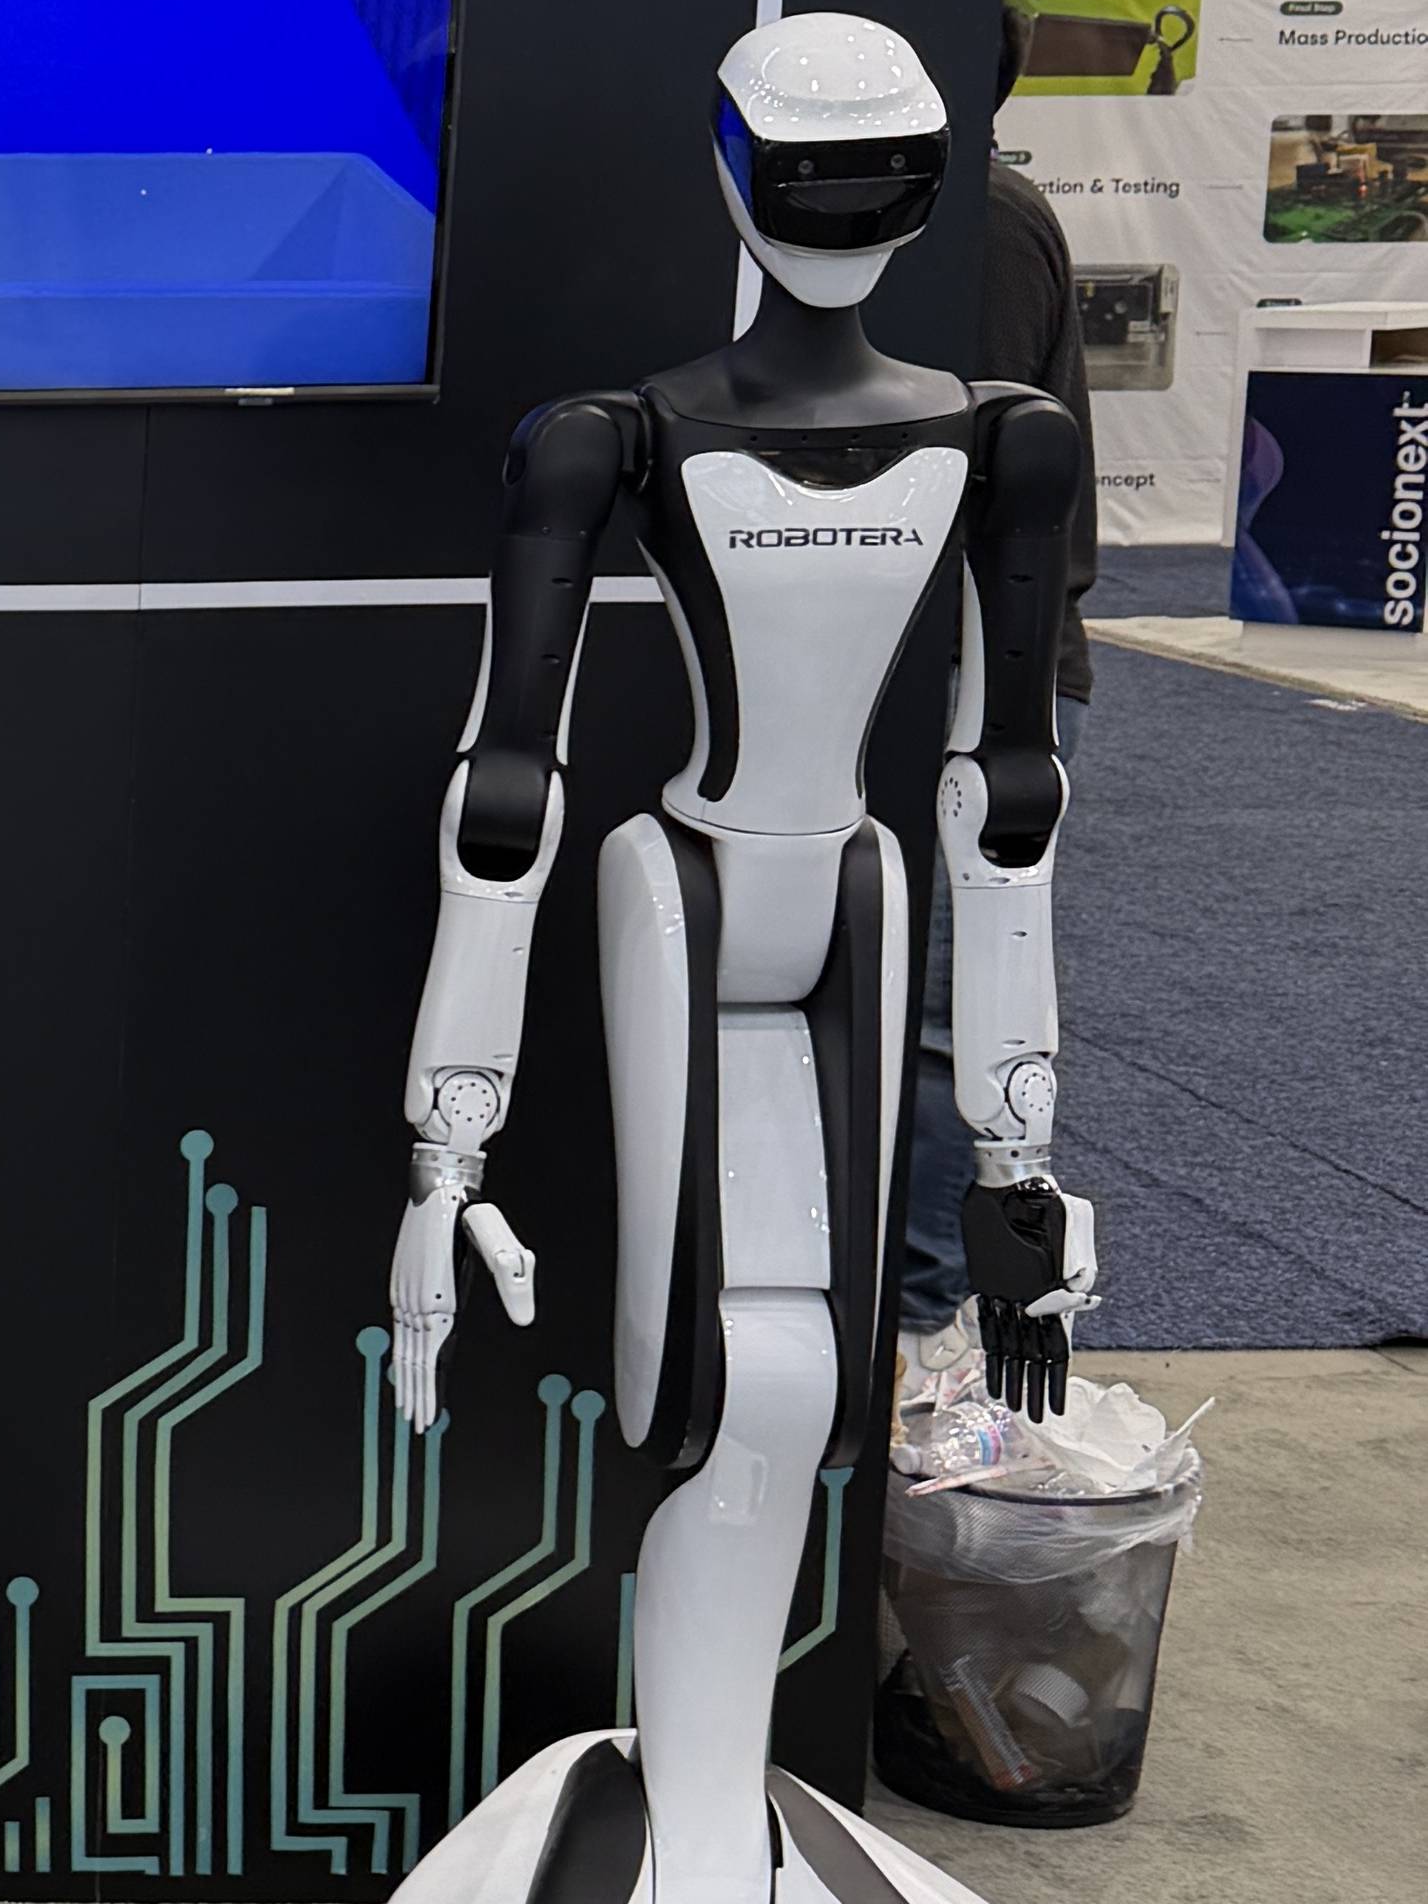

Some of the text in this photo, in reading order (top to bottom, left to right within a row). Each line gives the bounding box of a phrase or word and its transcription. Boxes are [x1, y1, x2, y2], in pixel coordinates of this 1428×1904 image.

[1278, 28, 1428, 46] Mass Productio
[1032, 177, 1181, 199] ation & Testing
[1097, 473, 1155, 491] ncept
[1381, 401, 1428, 627] socionext
[729, 528, 923, 549] ROBOTERA
